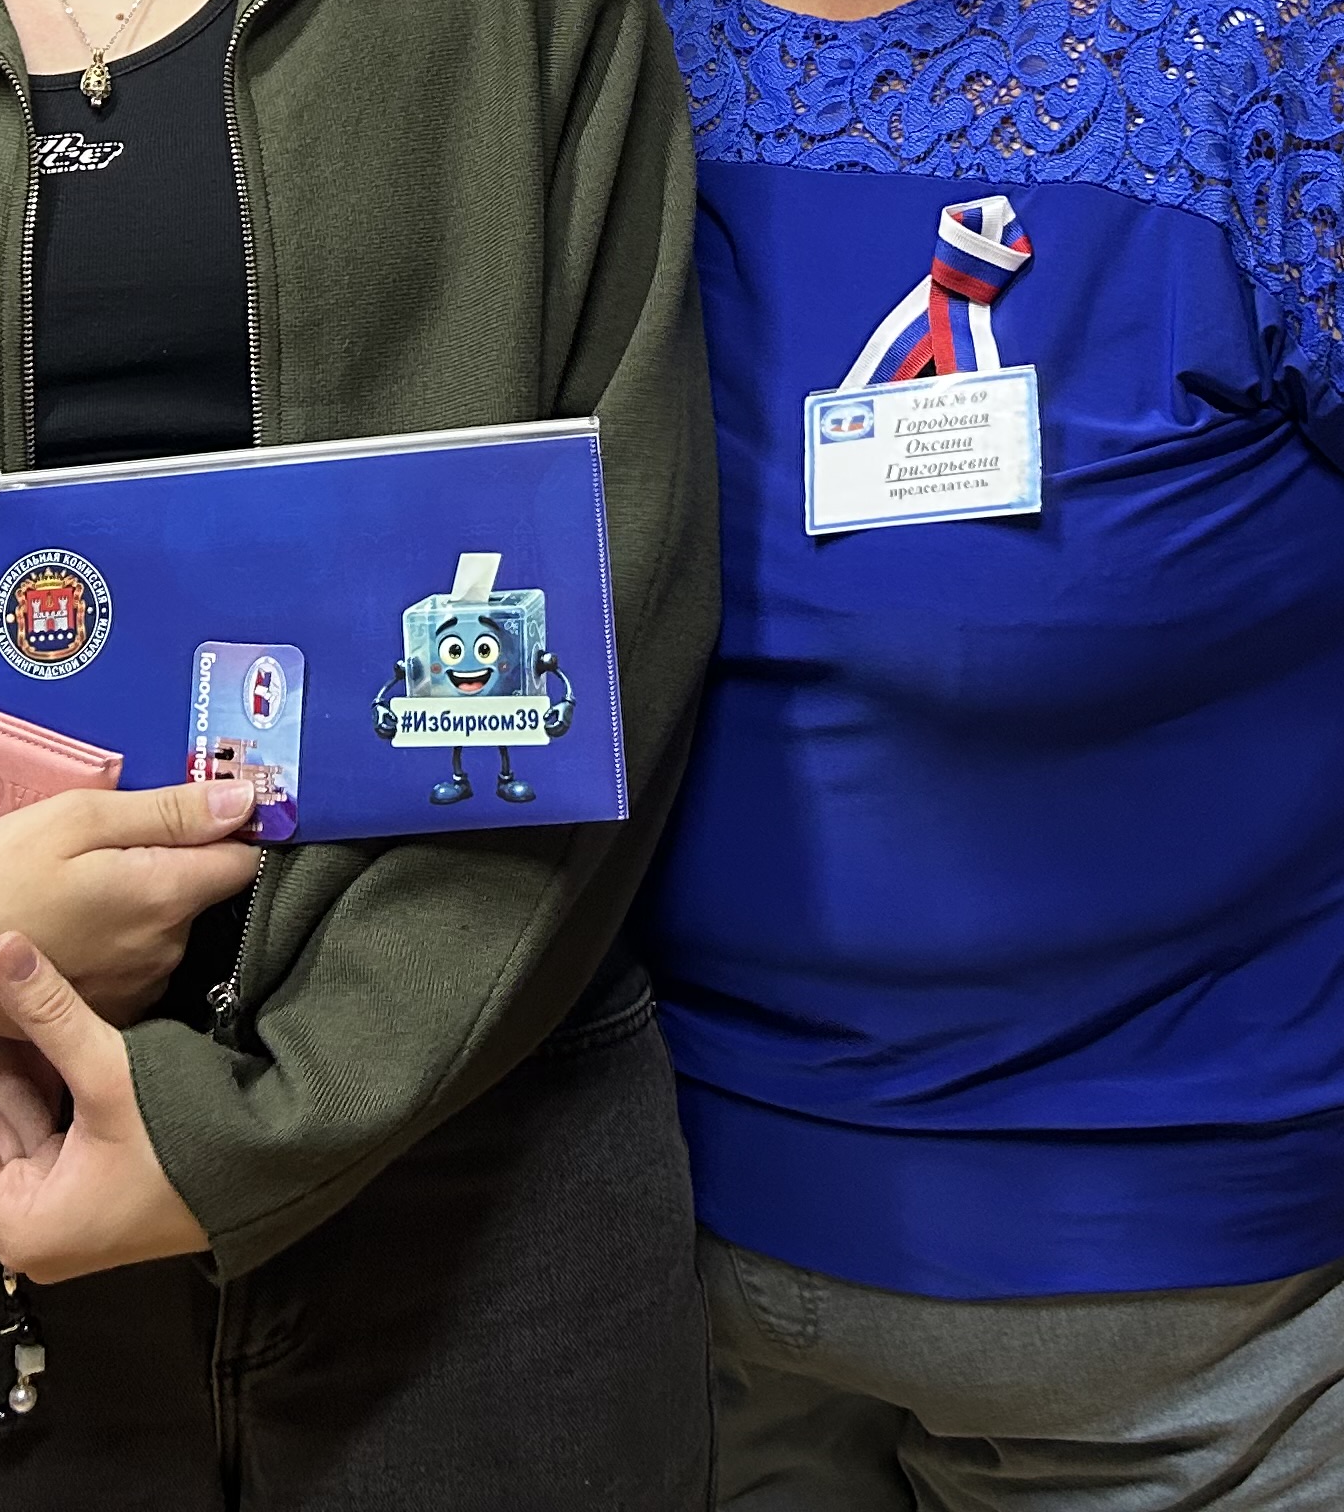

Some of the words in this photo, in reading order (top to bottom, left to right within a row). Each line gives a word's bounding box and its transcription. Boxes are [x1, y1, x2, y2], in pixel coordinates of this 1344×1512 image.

[912, 394, 948, 410] УИК
[950, 393, 966, 405] №
[970, 390, 988, 403] 69
[894, 413, 990, 435] Городовая
[905, 436, 973, 455] Оксана
[885, 456, 1000, 481] Григорьевна
[889, 478, 989, 500] председатель
[63, 554, 108, 603] КОМИССИЯ
[79, 618, 109, 663] ОБЛАСТИ
[194, 652, 217, 732] Голосую
[400, 708, 541, 738] #Избирком39
[190, 735, 207, 783] впер
